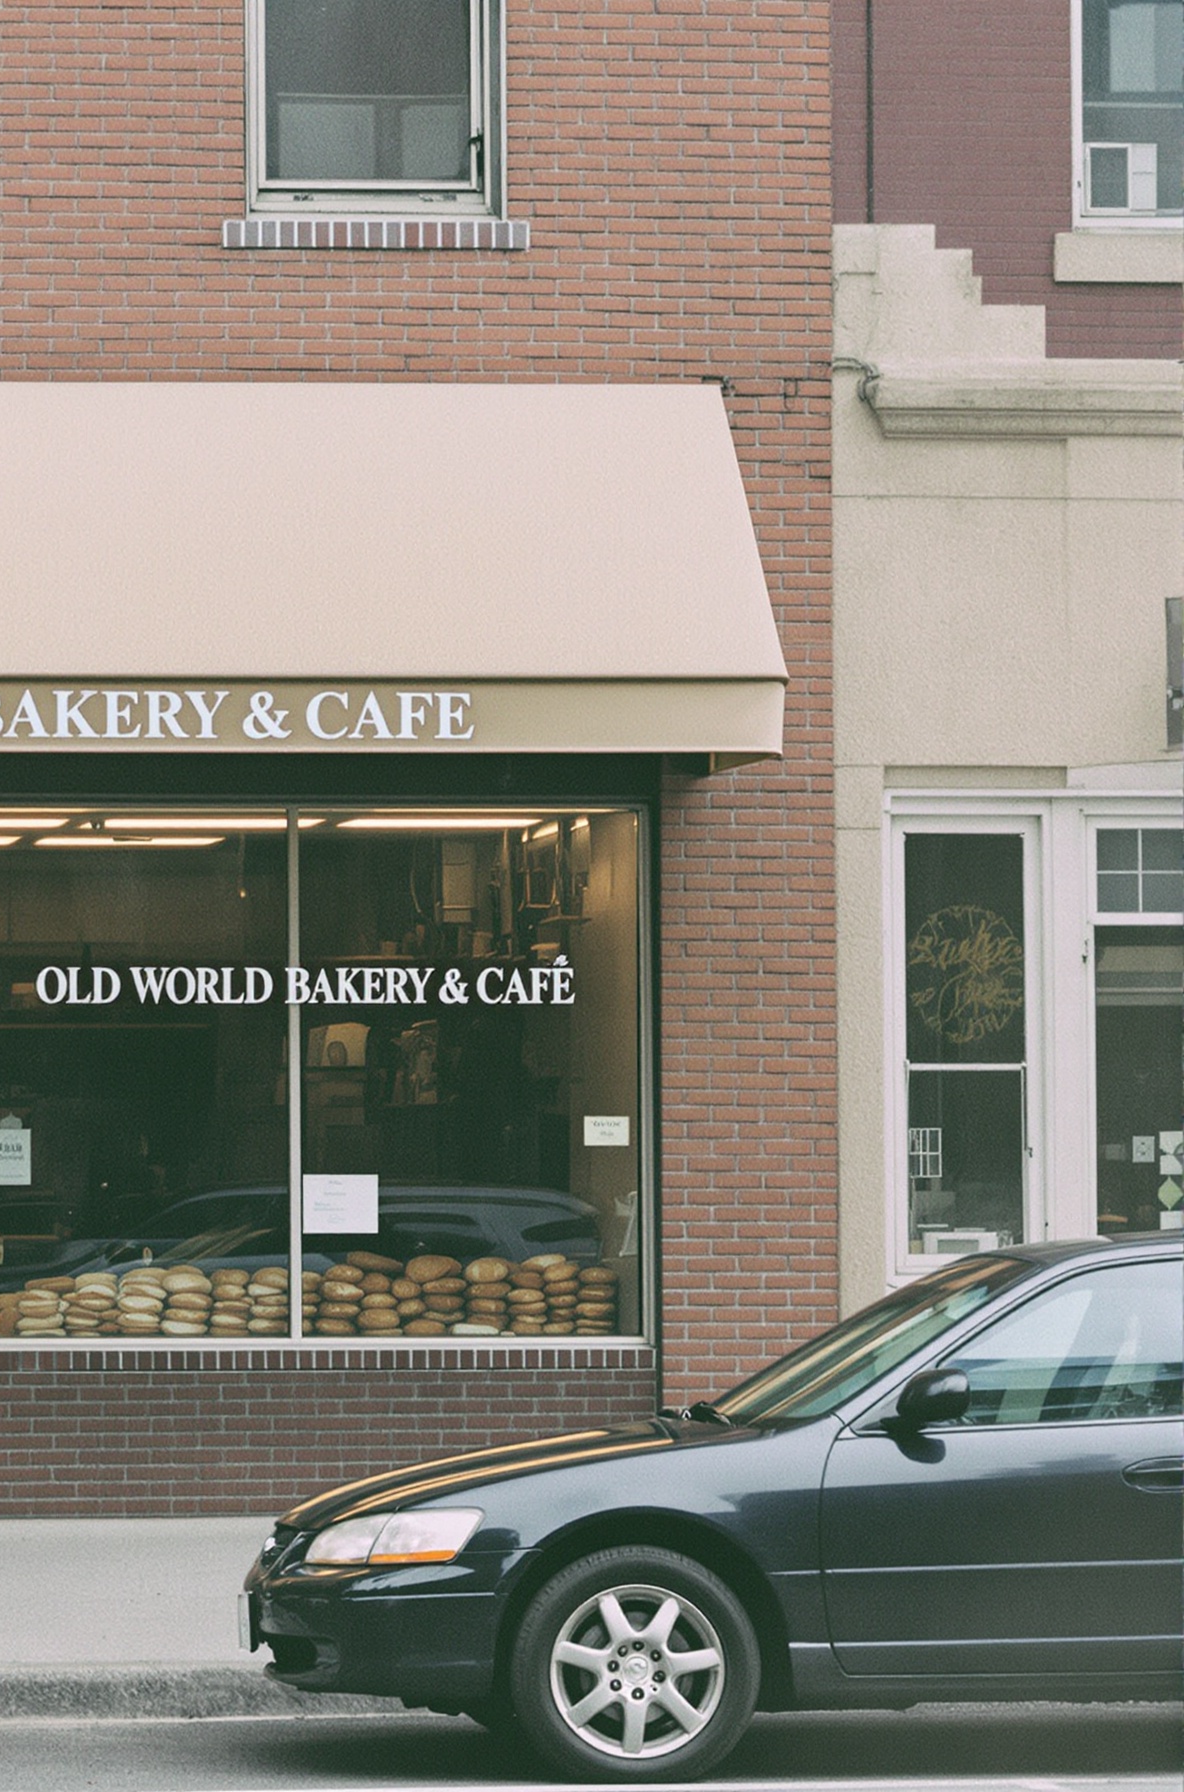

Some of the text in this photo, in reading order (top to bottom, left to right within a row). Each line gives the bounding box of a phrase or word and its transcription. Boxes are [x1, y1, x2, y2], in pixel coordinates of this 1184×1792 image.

[242, 691, 292, 739] &
[306, 690, 475, 740] CAFE
[36, 954, 576, 1004] OLD WORLD BAKERY & CAFÉ
